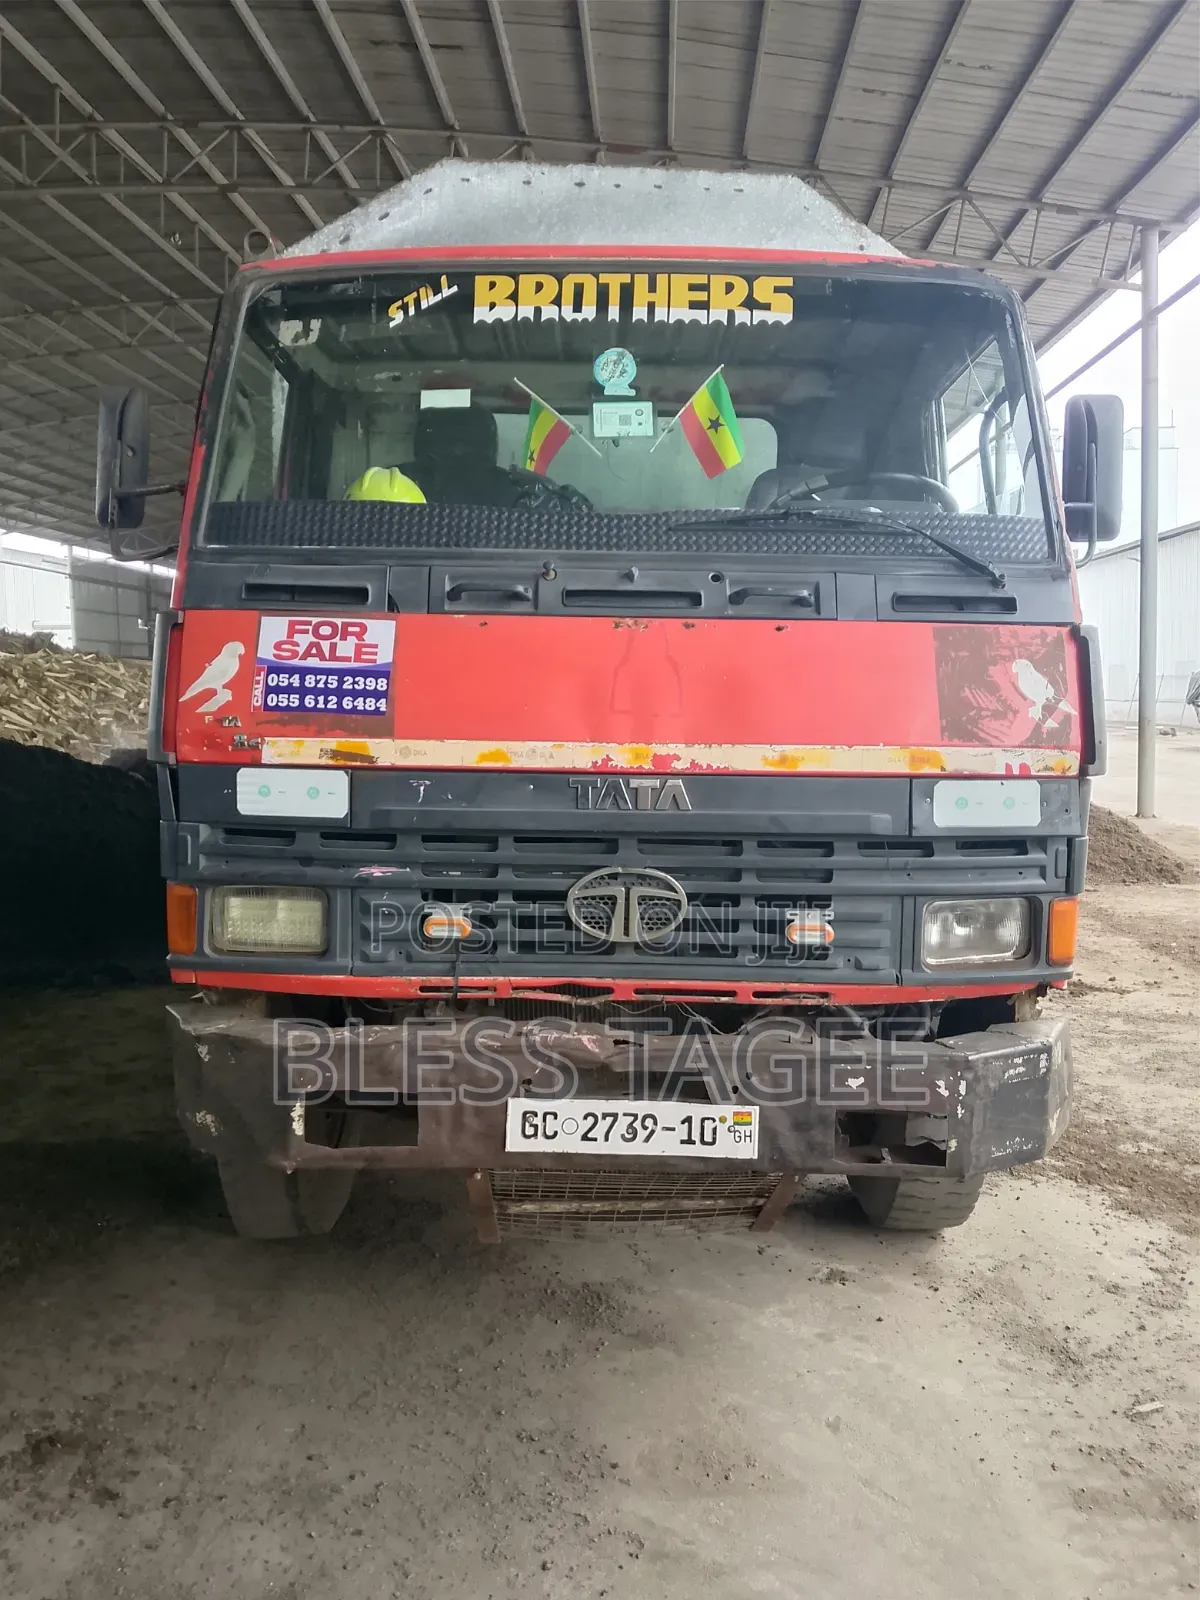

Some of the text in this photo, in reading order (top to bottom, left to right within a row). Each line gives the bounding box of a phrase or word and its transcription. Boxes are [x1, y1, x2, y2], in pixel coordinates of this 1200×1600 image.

[387, 273, 794, 328] STILL BROTHERS
[286, 619, 368, 642] FOR
[272, 639, 379, 664] SALE
[253, 671, 265, 707] CALL
[267, 673, 388, 691] 054 875 2398
[266, 693, 387, 712] 055 612 6484
[569, 777, 692, 811] TATA
[520, 1109, 753, 1146] GC 2739-10 GH
